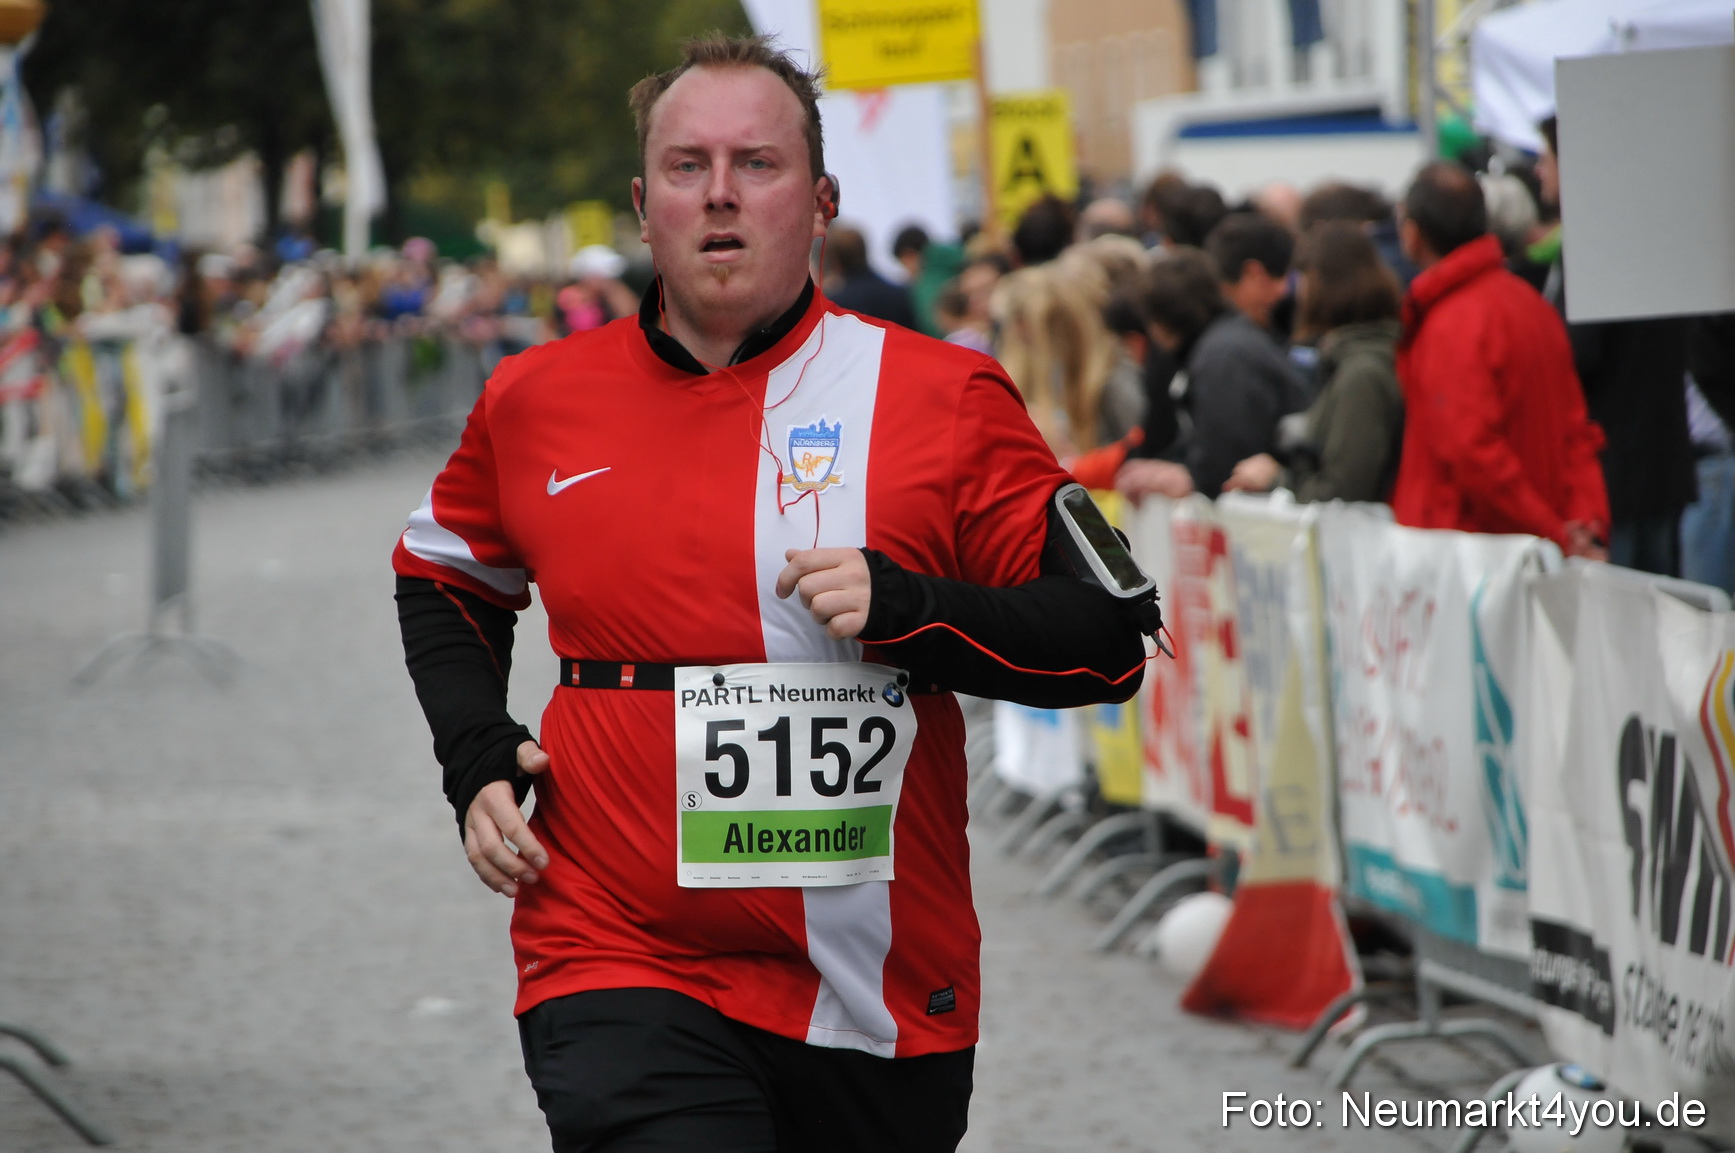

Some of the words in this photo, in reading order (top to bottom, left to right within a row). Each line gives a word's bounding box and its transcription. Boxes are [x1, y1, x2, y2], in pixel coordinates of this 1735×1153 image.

[1004, 131, 1046, 192] A
[681, 686, 762, 707] PARTL
[769, 684, 876, 703] Neumarkt
[704, 716, 896, 799] 5152
[687, 793, 697, 808] S
[723, 821, 866, 853] Alexander
